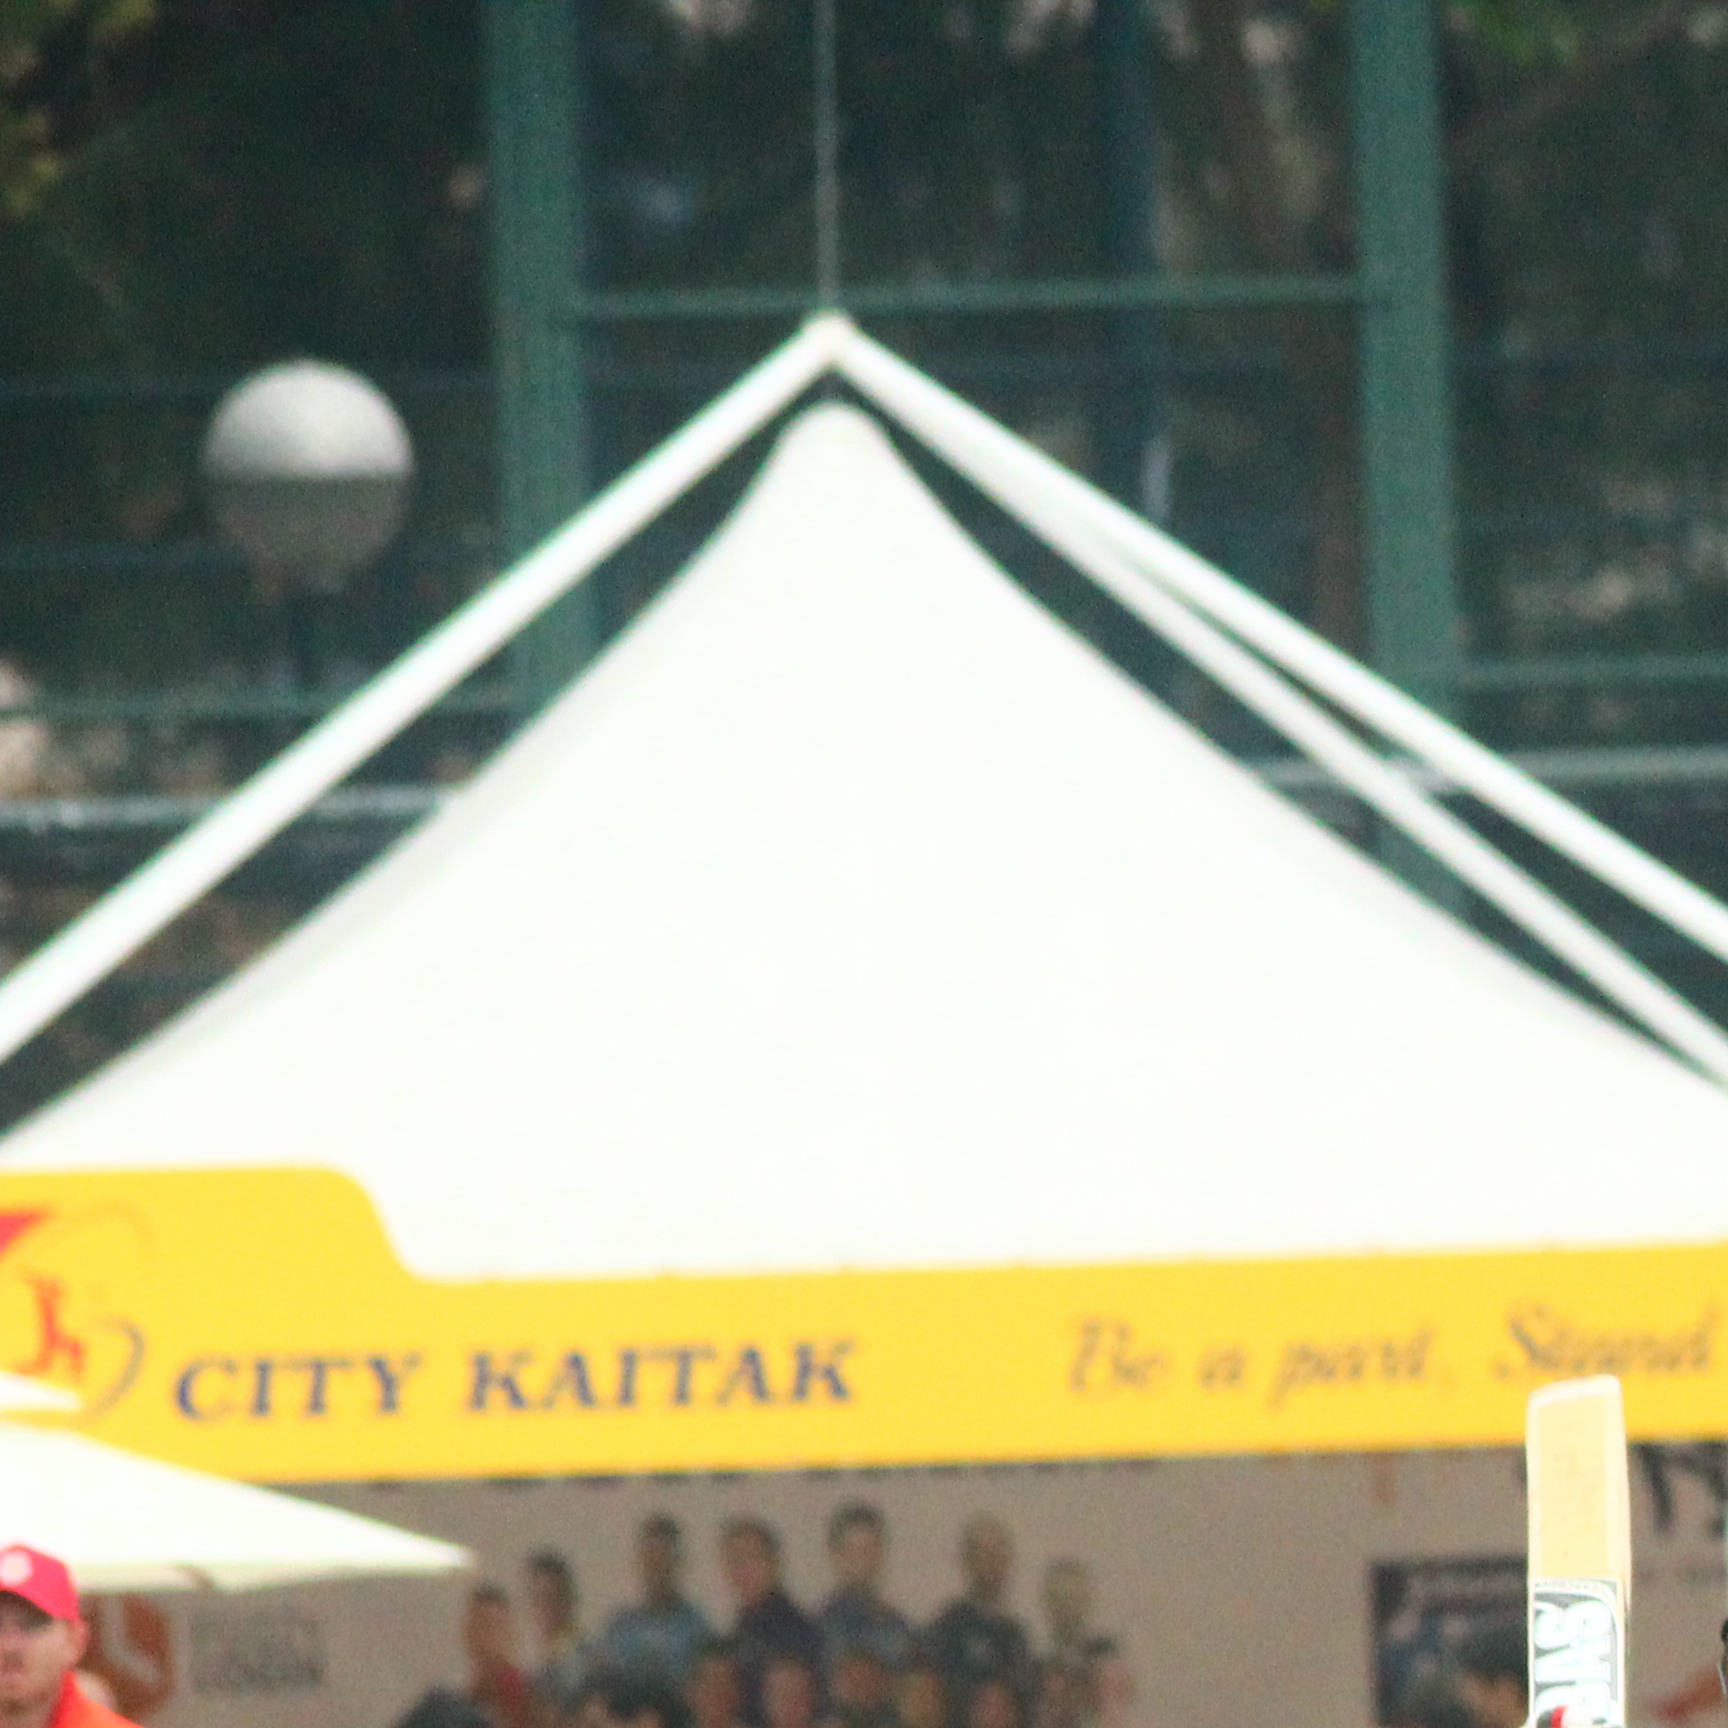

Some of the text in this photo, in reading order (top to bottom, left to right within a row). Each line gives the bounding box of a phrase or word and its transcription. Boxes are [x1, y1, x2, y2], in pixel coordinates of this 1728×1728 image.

[177, 1341, 857, 1422] CITY KAITAK
[1070, 1314, 1168, 1395] Be
[1196, 1343, 1247, 1392] a
